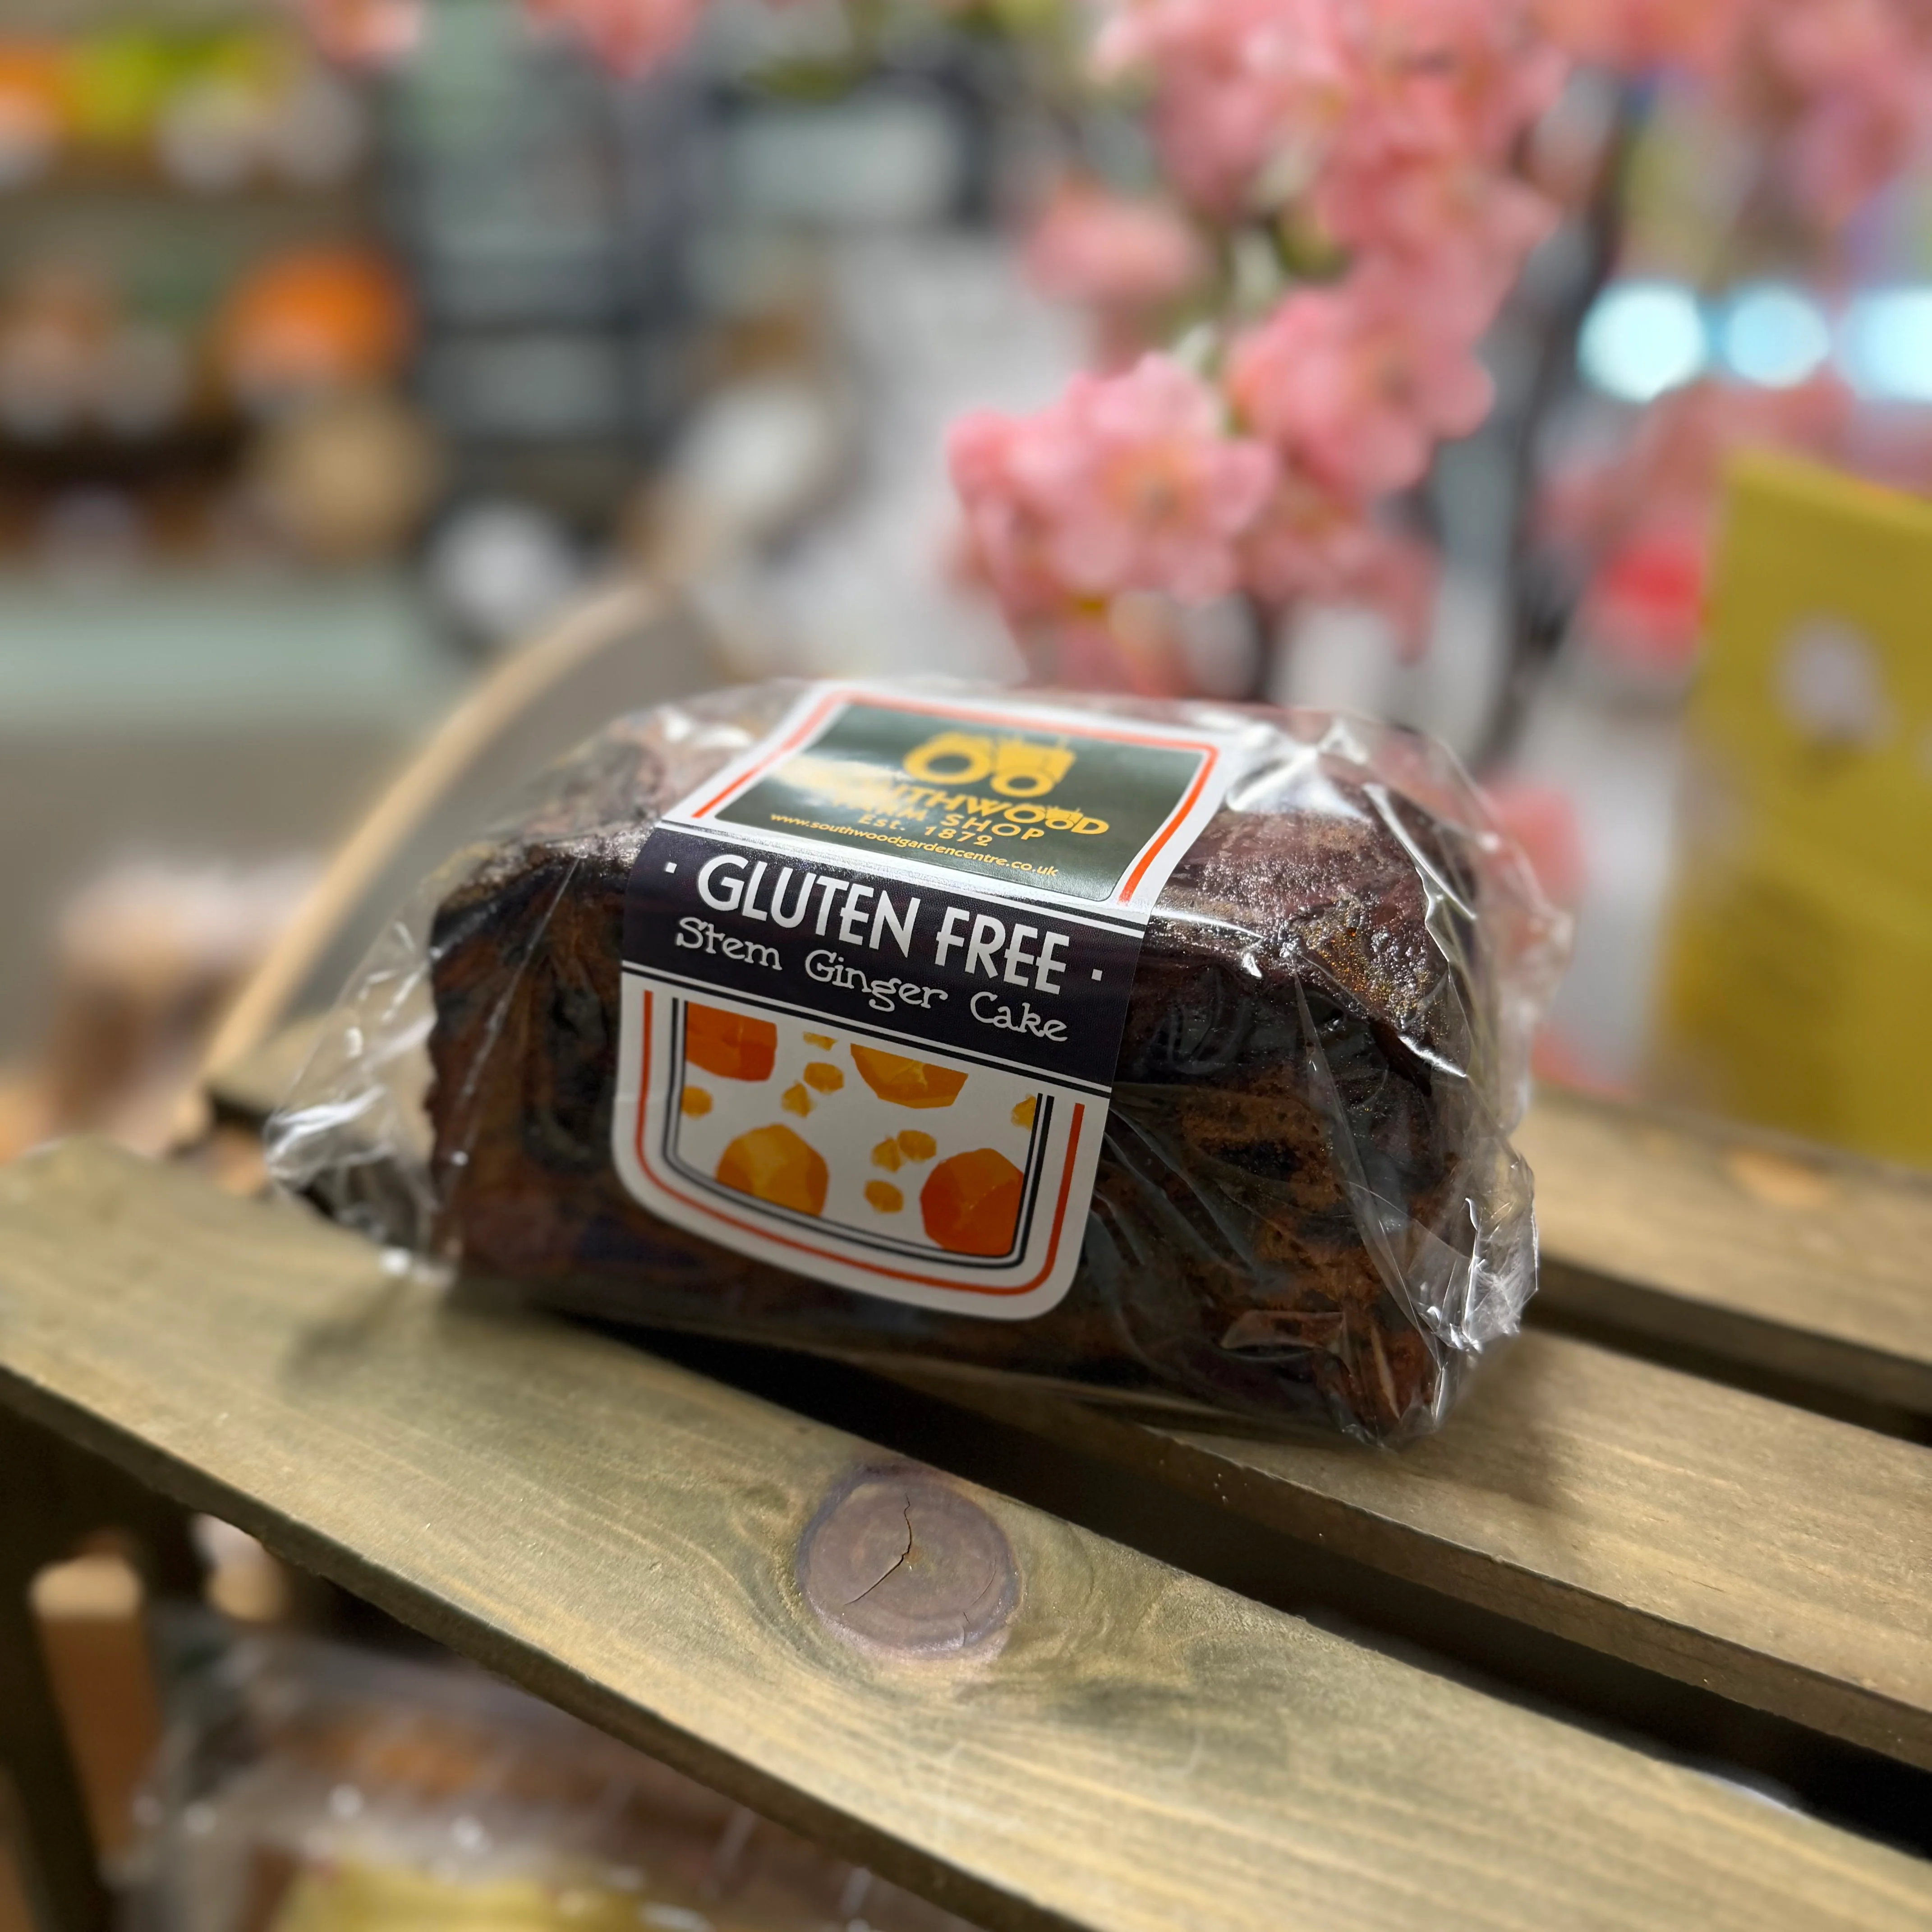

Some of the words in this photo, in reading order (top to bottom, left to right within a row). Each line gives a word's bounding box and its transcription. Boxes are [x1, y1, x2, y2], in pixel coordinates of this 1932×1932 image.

[803, 764, 1109, 834] THWOOD
[859, 814, 906, 831] Est.
[925, 826, 993, 847] 1872
[940, 813, 1045, 840] SHOP
[770, 813, 1059, 877] www.southwoodgardencentre.co.uk
[697, 854, 921, 958] GLUTEN
[935, 906, 1070, 995] FREE
[676, 917, 782, 971] Stem
[805, 950, 948, 1012] Ginger
[970, 992, 1068, 1042] Cake
